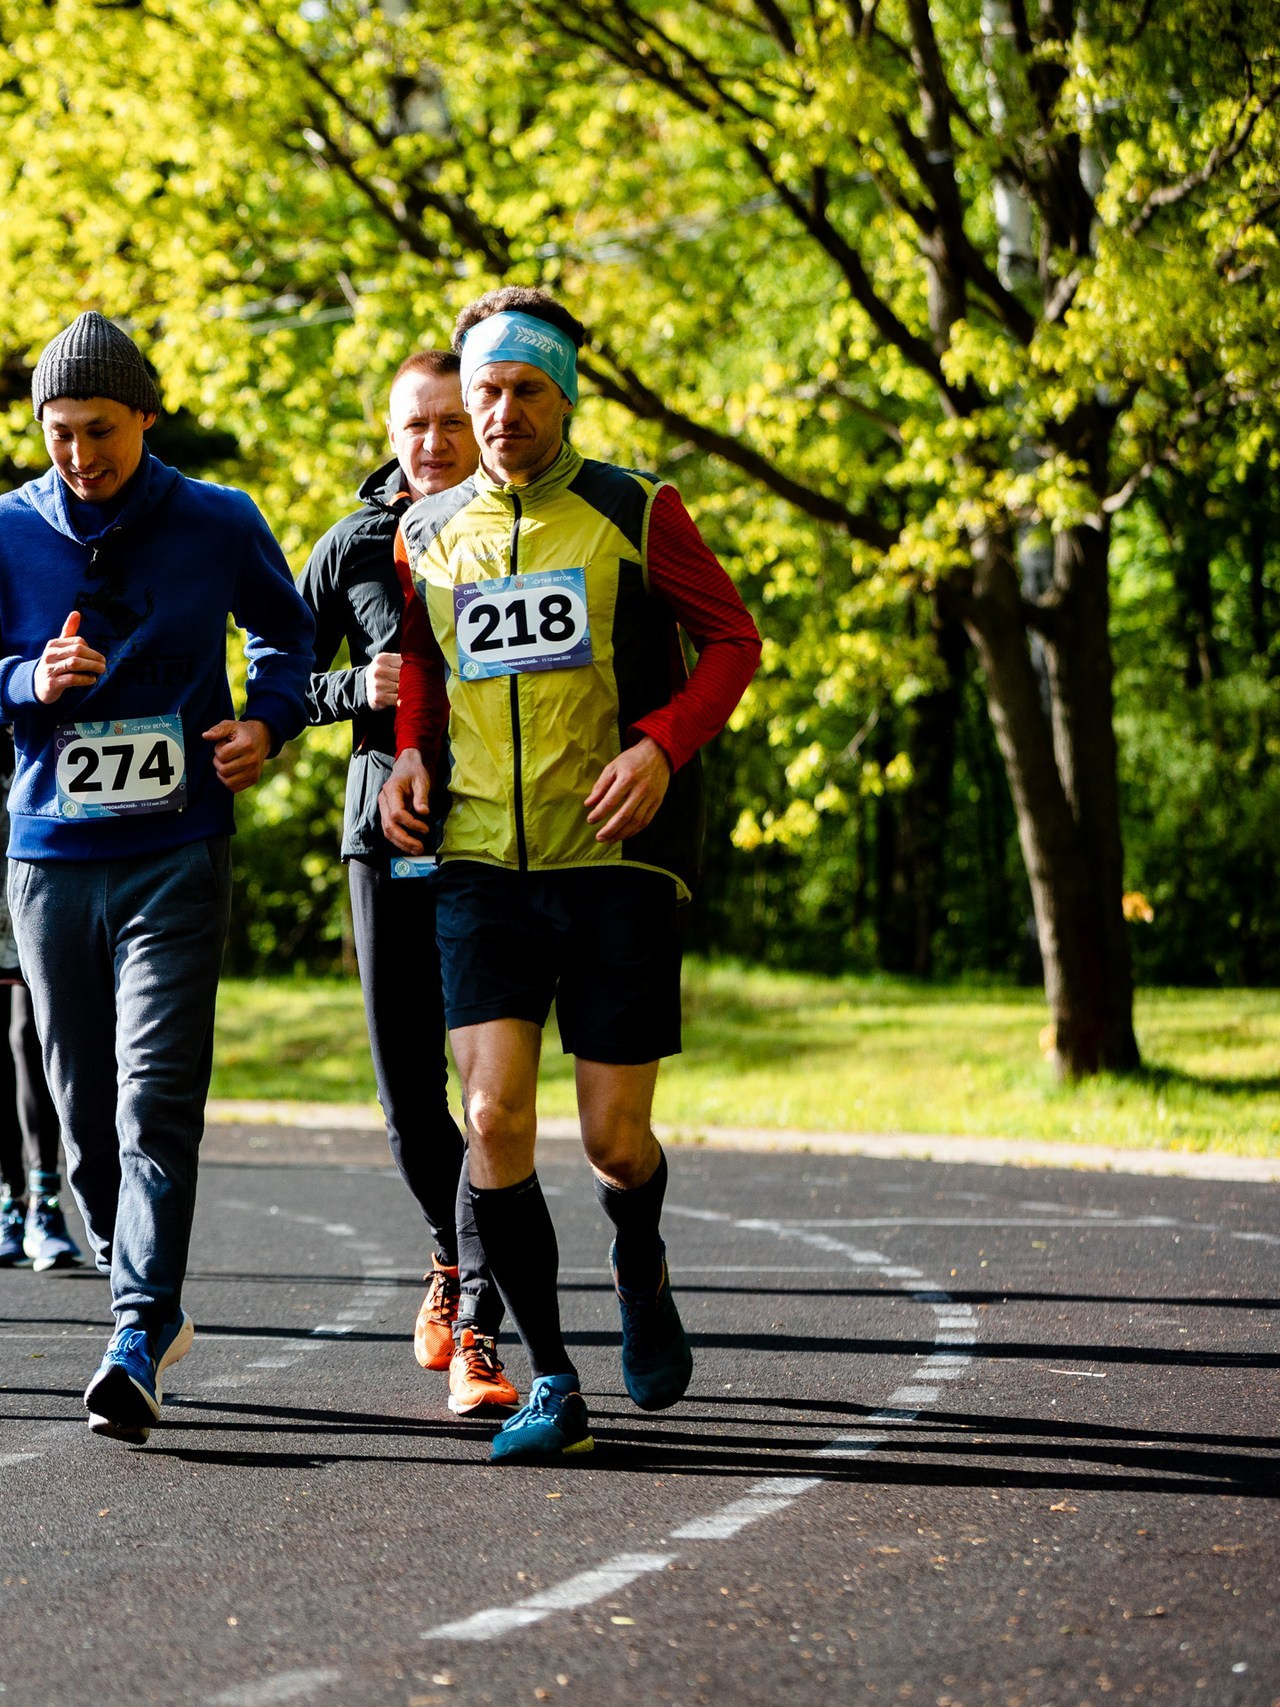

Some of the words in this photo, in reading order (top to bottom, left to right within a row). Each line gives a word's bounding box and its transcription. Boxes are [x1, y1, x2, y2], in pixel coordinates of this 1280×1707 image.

[514, 333, 553, 354] TRAILS
[468, 594, 576, 653] 218
[67, 740, 175, 793] 274
